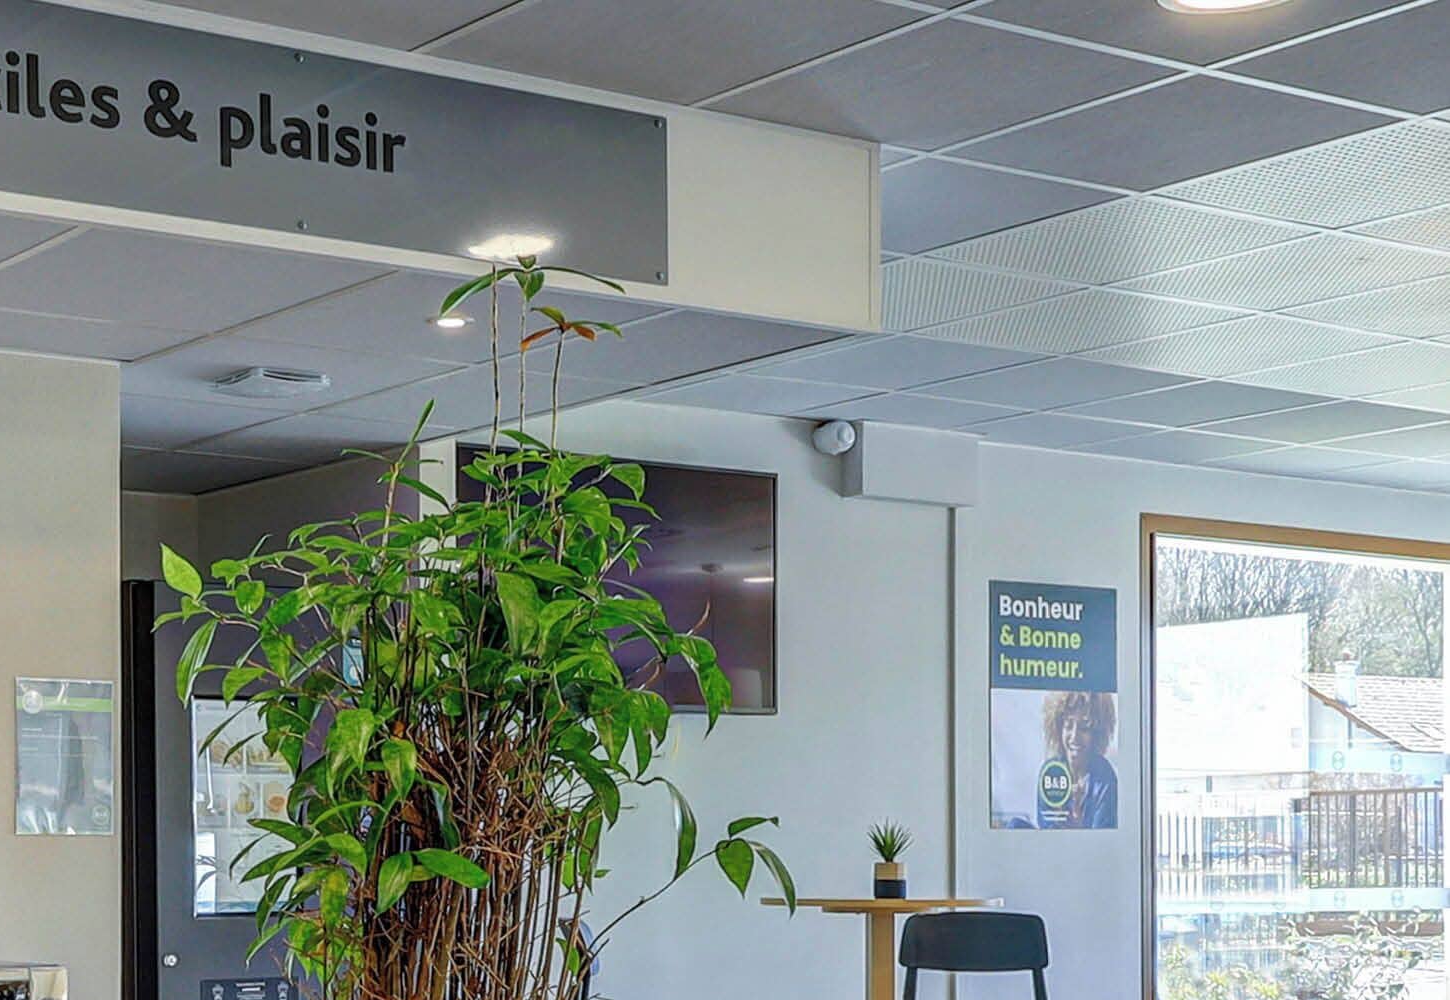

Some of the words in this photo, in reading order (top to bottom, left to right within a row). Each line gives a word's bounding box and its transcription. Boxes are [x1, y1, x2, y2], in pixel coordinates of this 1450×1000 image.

[143, 79, 197, 143] &
[219, 93, 407, 173] plaisir
[999, 594, 1084, 621] Bonheur
[999, 624, 1015, 646] &
[1018, 627, 1082, 649] Bonne
[999, 653, 1084, 679] humeur.
